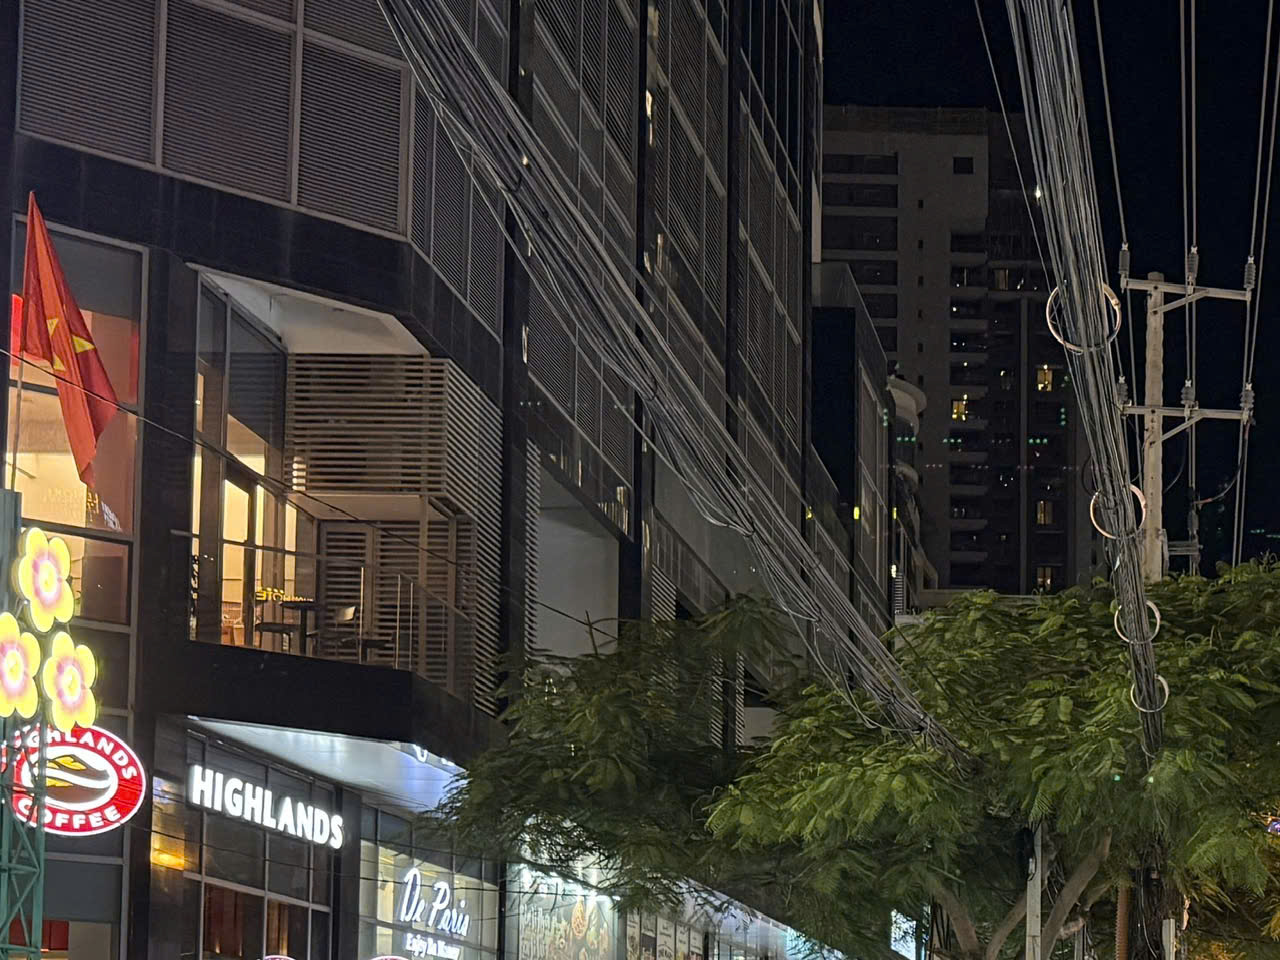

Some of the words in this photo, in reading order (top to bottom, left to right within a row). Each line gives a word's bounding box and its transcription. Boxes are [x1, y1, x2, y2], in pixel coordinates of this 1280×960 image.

[188, 764, 344, 850] HIGHLANDS
[400, 867, 425, 923] De
[428, 881, 470, 937] Paris
